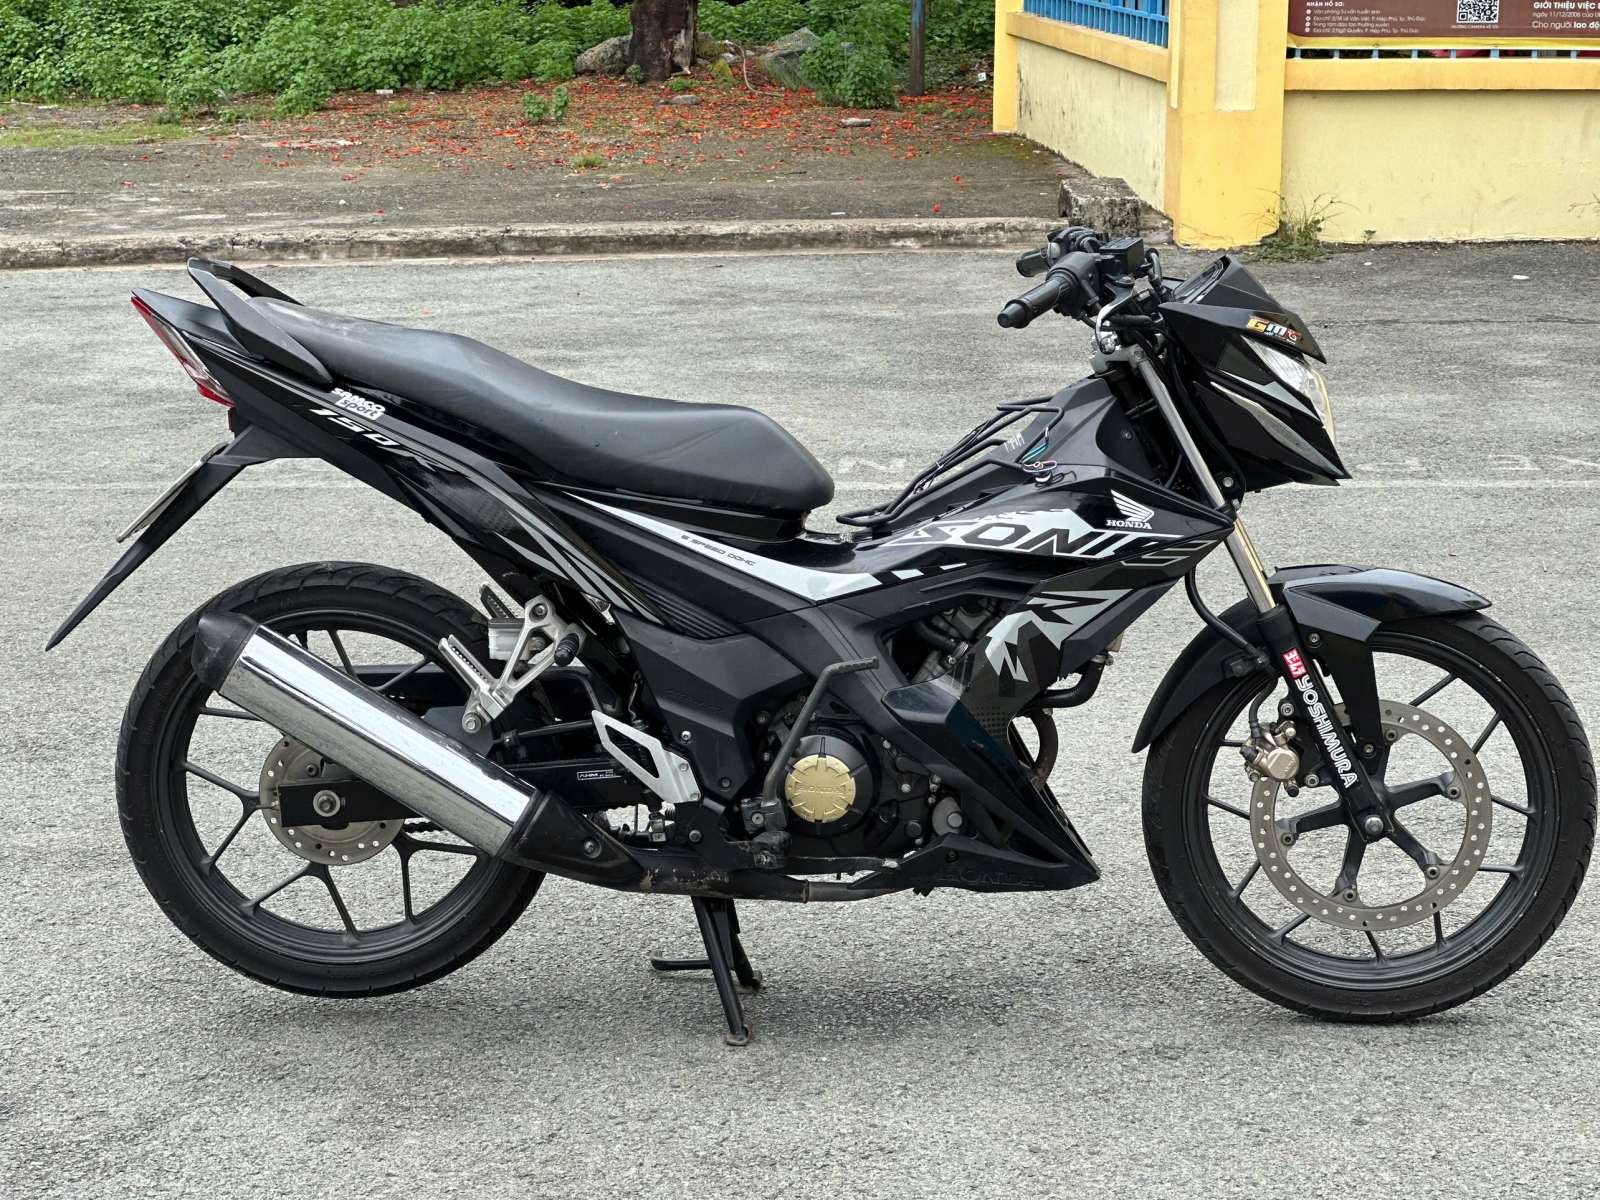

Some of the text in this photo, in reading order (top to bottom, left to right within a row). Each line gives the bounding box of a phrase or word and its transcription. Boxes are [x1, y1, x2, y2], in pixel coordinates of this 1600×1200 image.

[1533, 0, 1552, 9] GIỚI
[1554, 0, 1575, 11] THIỆU
[1577, 0, 1596, 11] VIỆC
[1532, 20, 1549, 28] Cho
[1550, 20, 1573, 30] người
[340, 398, 380, 418] sport
[1105, 519, 1153, 530] HONDA
[691, 538, 726, 555] SPEED
[727, 552, 756, 567] DOHC
[1294, 673, 1358, 789] YOSHIMURA
[797, 785, 844, 795] HONDA
[936, 868, 1045, 888] HONDA
